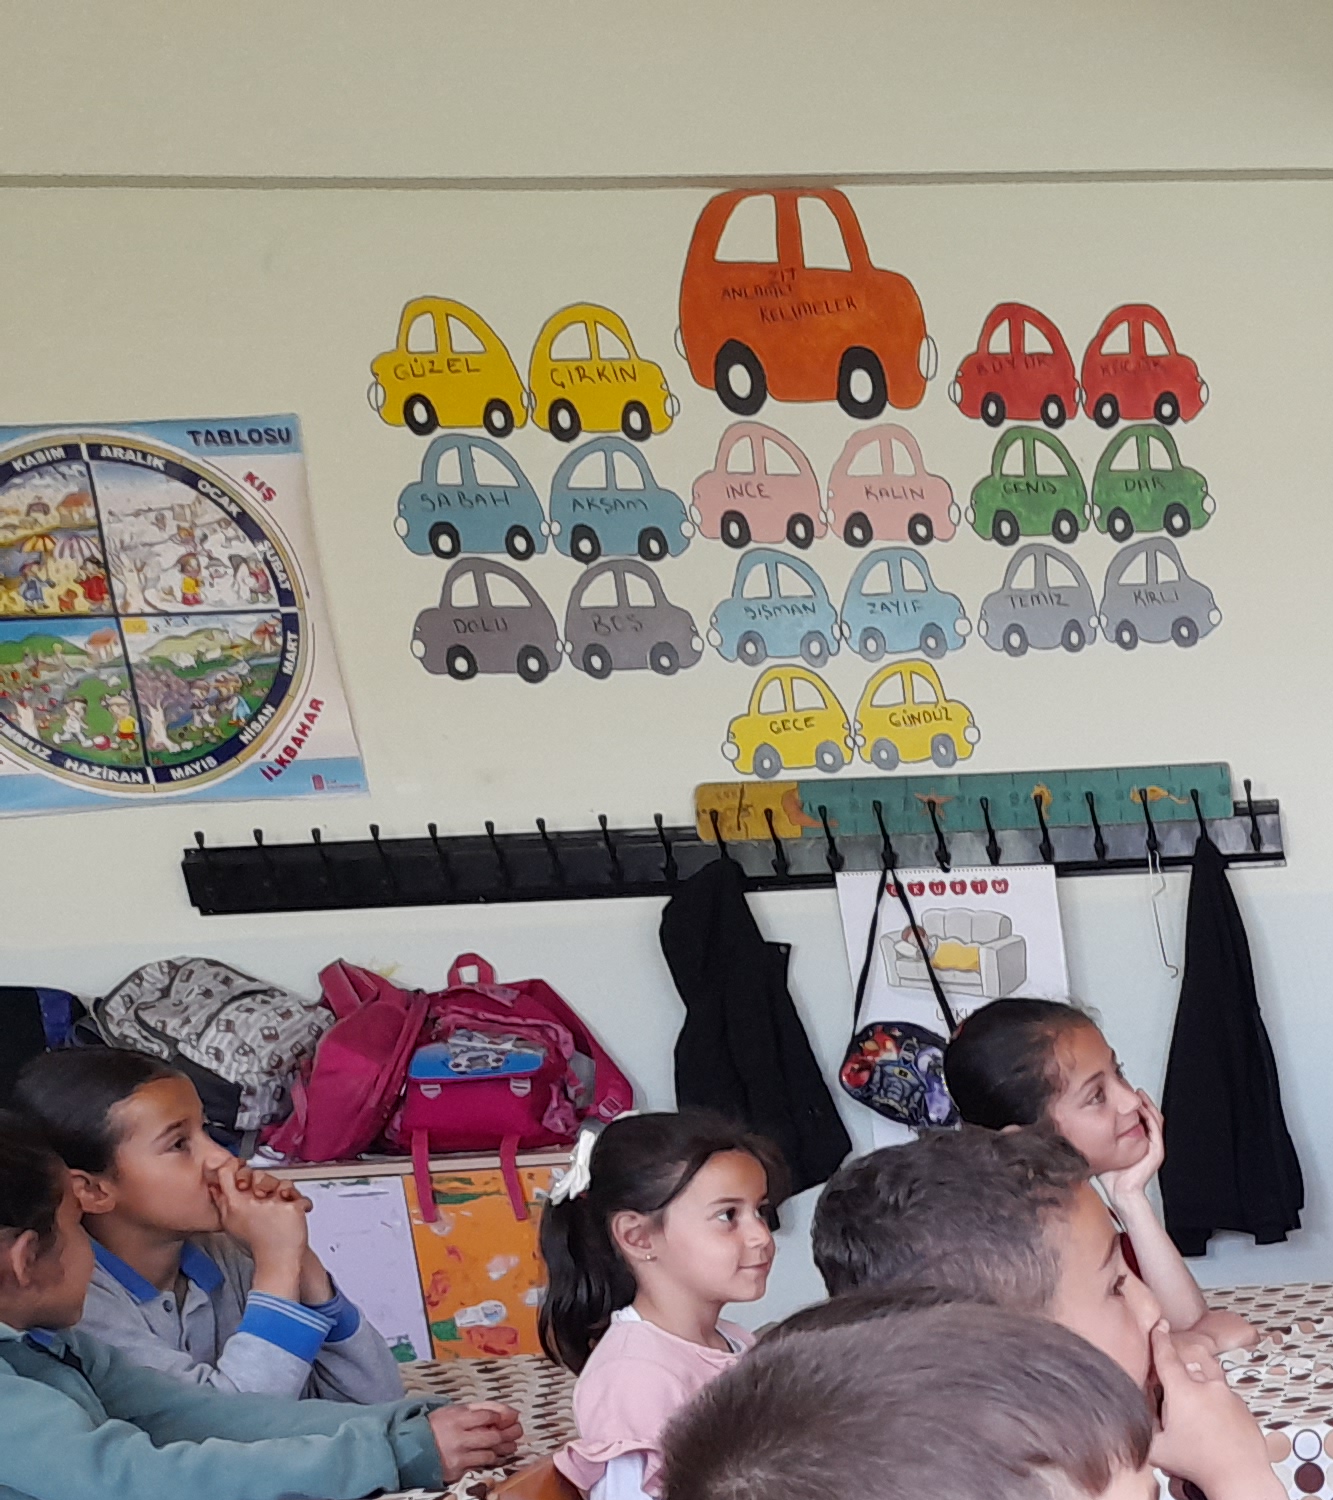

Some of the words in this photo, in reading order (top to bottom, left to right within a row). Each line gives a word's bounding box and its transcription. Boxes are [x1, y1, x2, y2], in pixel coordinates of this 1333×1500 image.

[393, 356, 481, 381] GÜZEL
[186, 427, 292, 447] TABLOSU
[100, 445, 167, 472] ARALIK
[197, 478, 243, 519] OCAK
[420, 489, 510, 512] SABAH
[281, 630, 299, 676] MART
[769, 716, 815, 735] GECE
